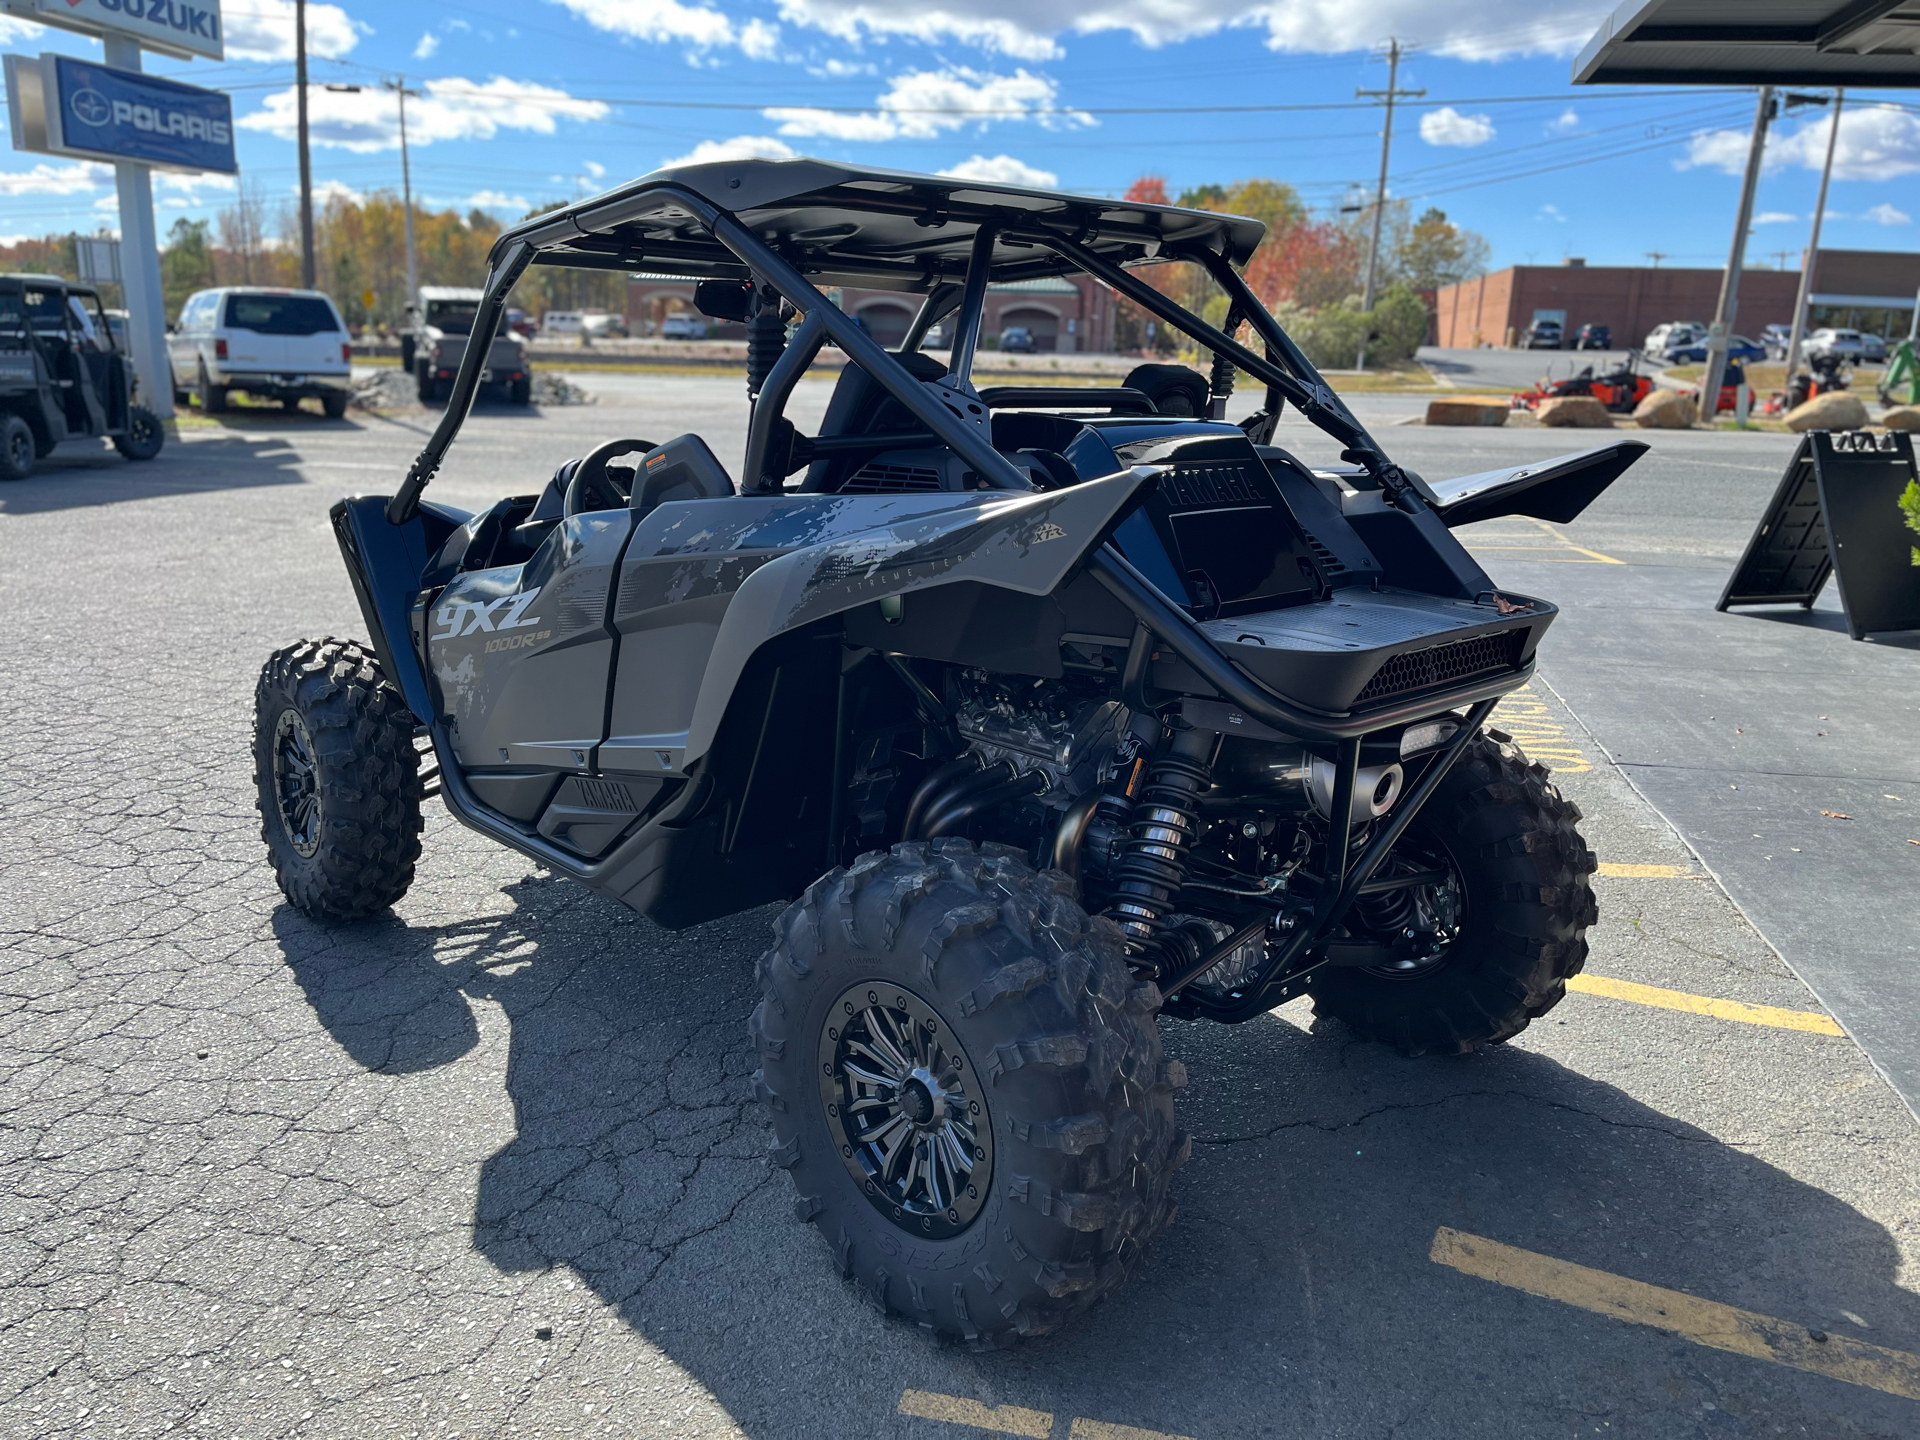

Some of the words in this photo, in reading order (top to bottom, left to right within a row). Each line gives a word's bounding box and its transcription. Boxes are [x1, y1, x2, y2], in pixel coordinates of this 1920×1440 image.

[113, 101, 231, 145] POLARIS
[1160, 467, 1265, 506] YAMAHA
[1034, 527, 1064, 543] XT-R
[846, 569, 912, 593] XTREME
[931, 541, 1018, 570] TERRAIN
[431, 587, 541, 641] YXZ
[574, 779, 638, 812] YAMAHA
